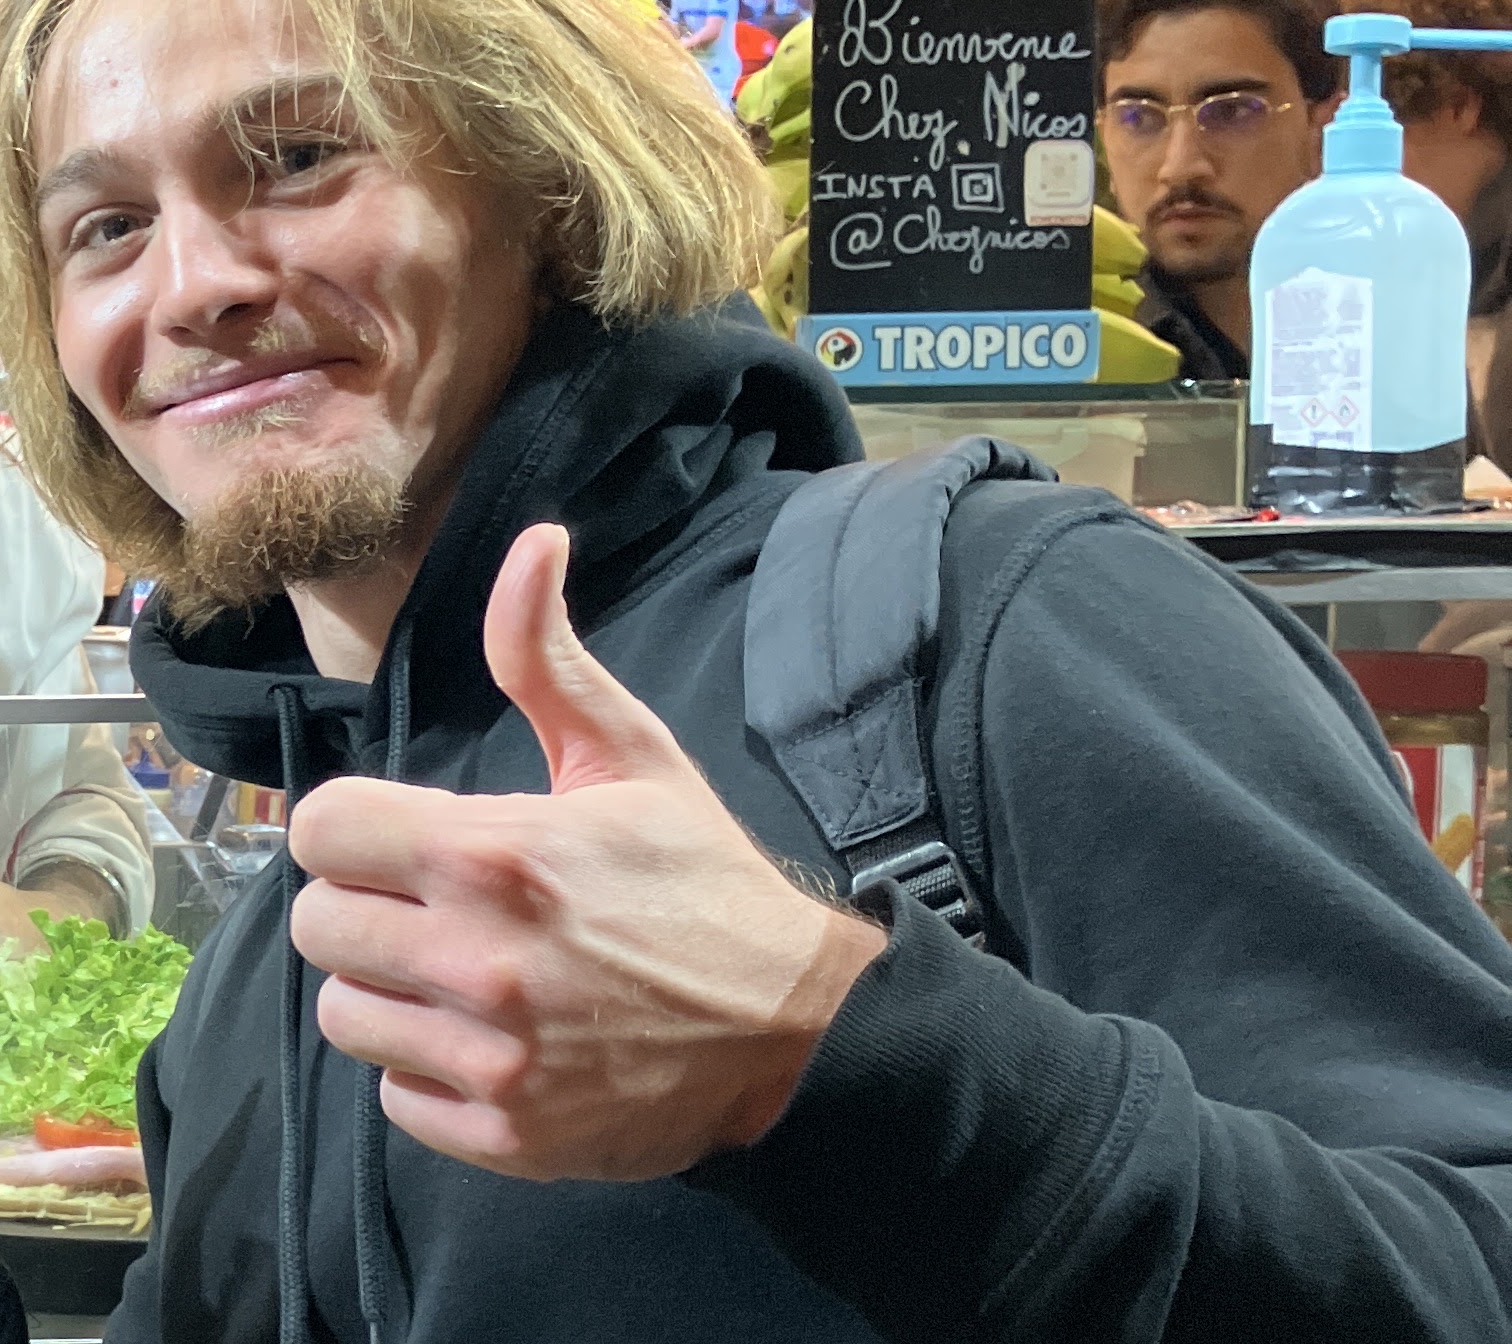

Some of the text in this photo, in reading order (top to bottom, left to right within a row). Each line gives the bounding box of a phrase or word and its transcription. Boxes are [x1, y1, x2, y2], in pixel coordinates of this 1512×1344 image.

[835, 73, 958, 171] Chez
[813, 172, 936, 202] INSTA
[873, 321, 1087, 372] TROPICO
